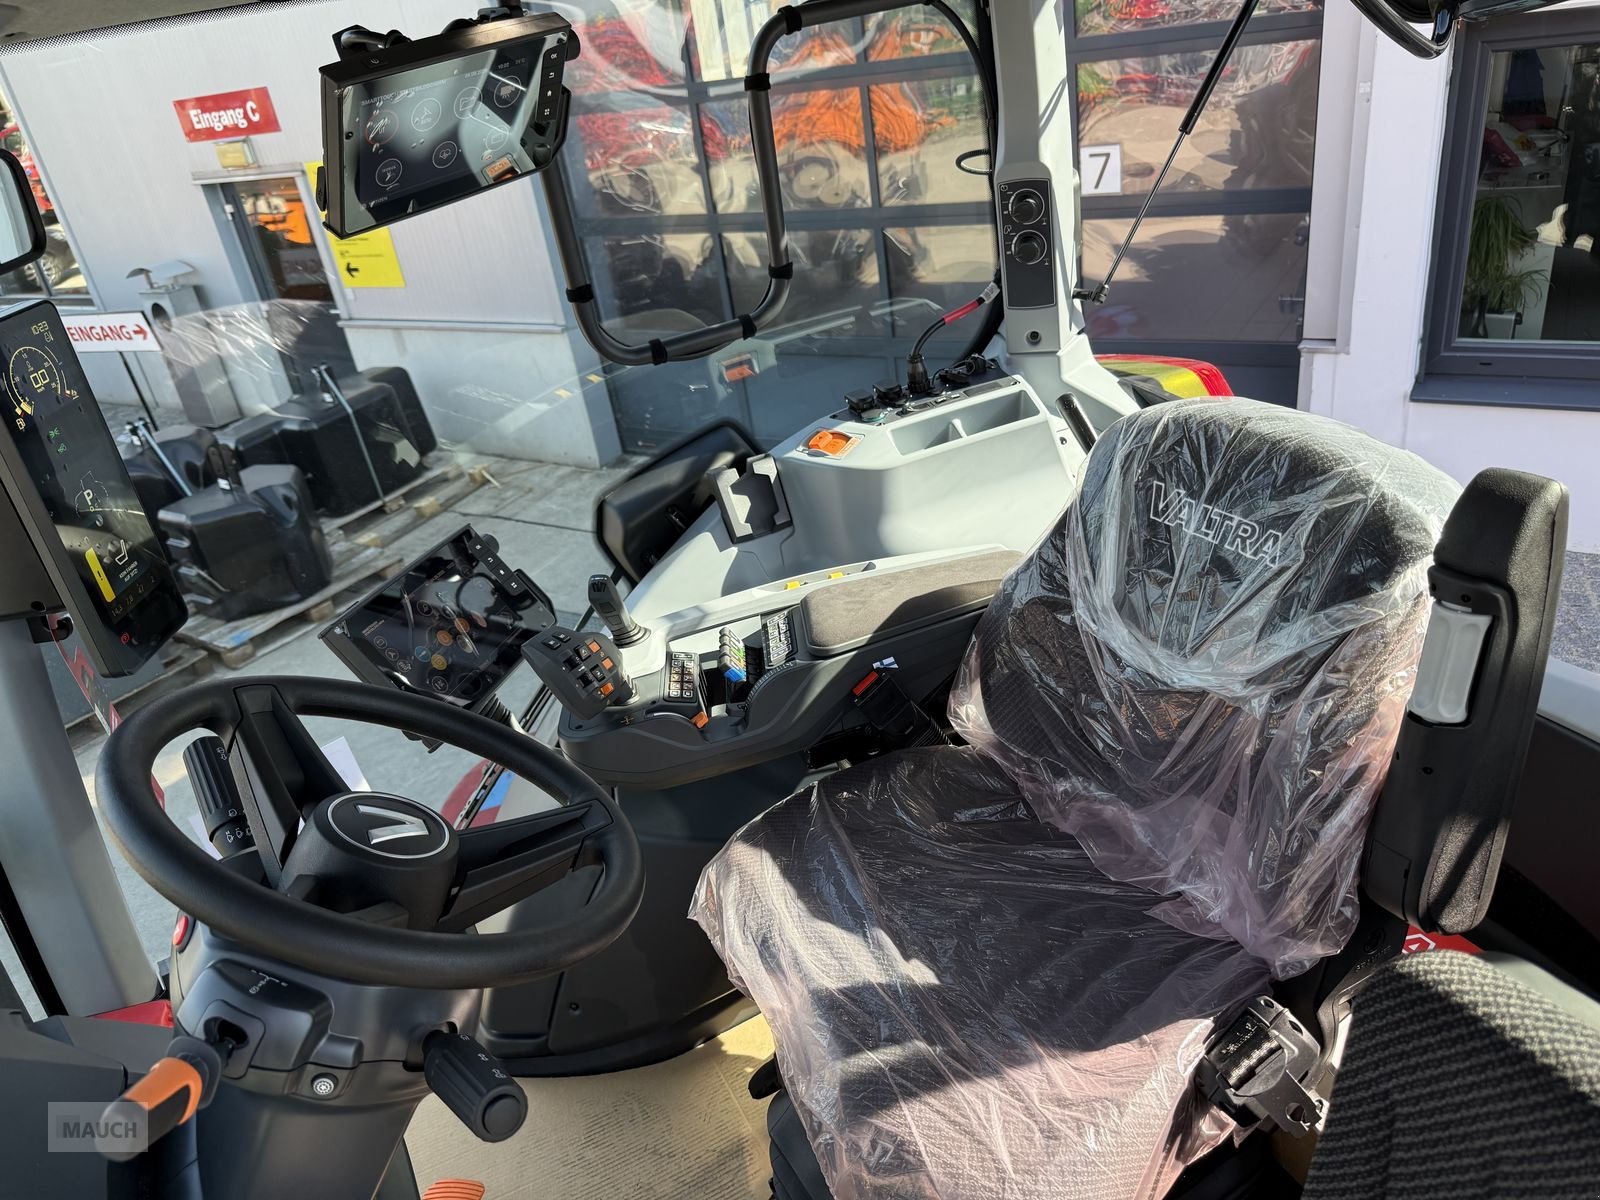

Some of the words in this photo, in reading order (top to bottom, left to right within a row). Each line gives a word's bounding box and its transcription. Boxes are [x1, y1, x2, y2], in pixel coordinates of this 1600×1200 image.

[189, 107, 248, 132] Eingang
[245, 100, 260, 122] C
[1089, 152, 1111, 190] 7
[66, 324, 133, 342] EINGANG
[1149, 480, 1283, 569] VALTRA
